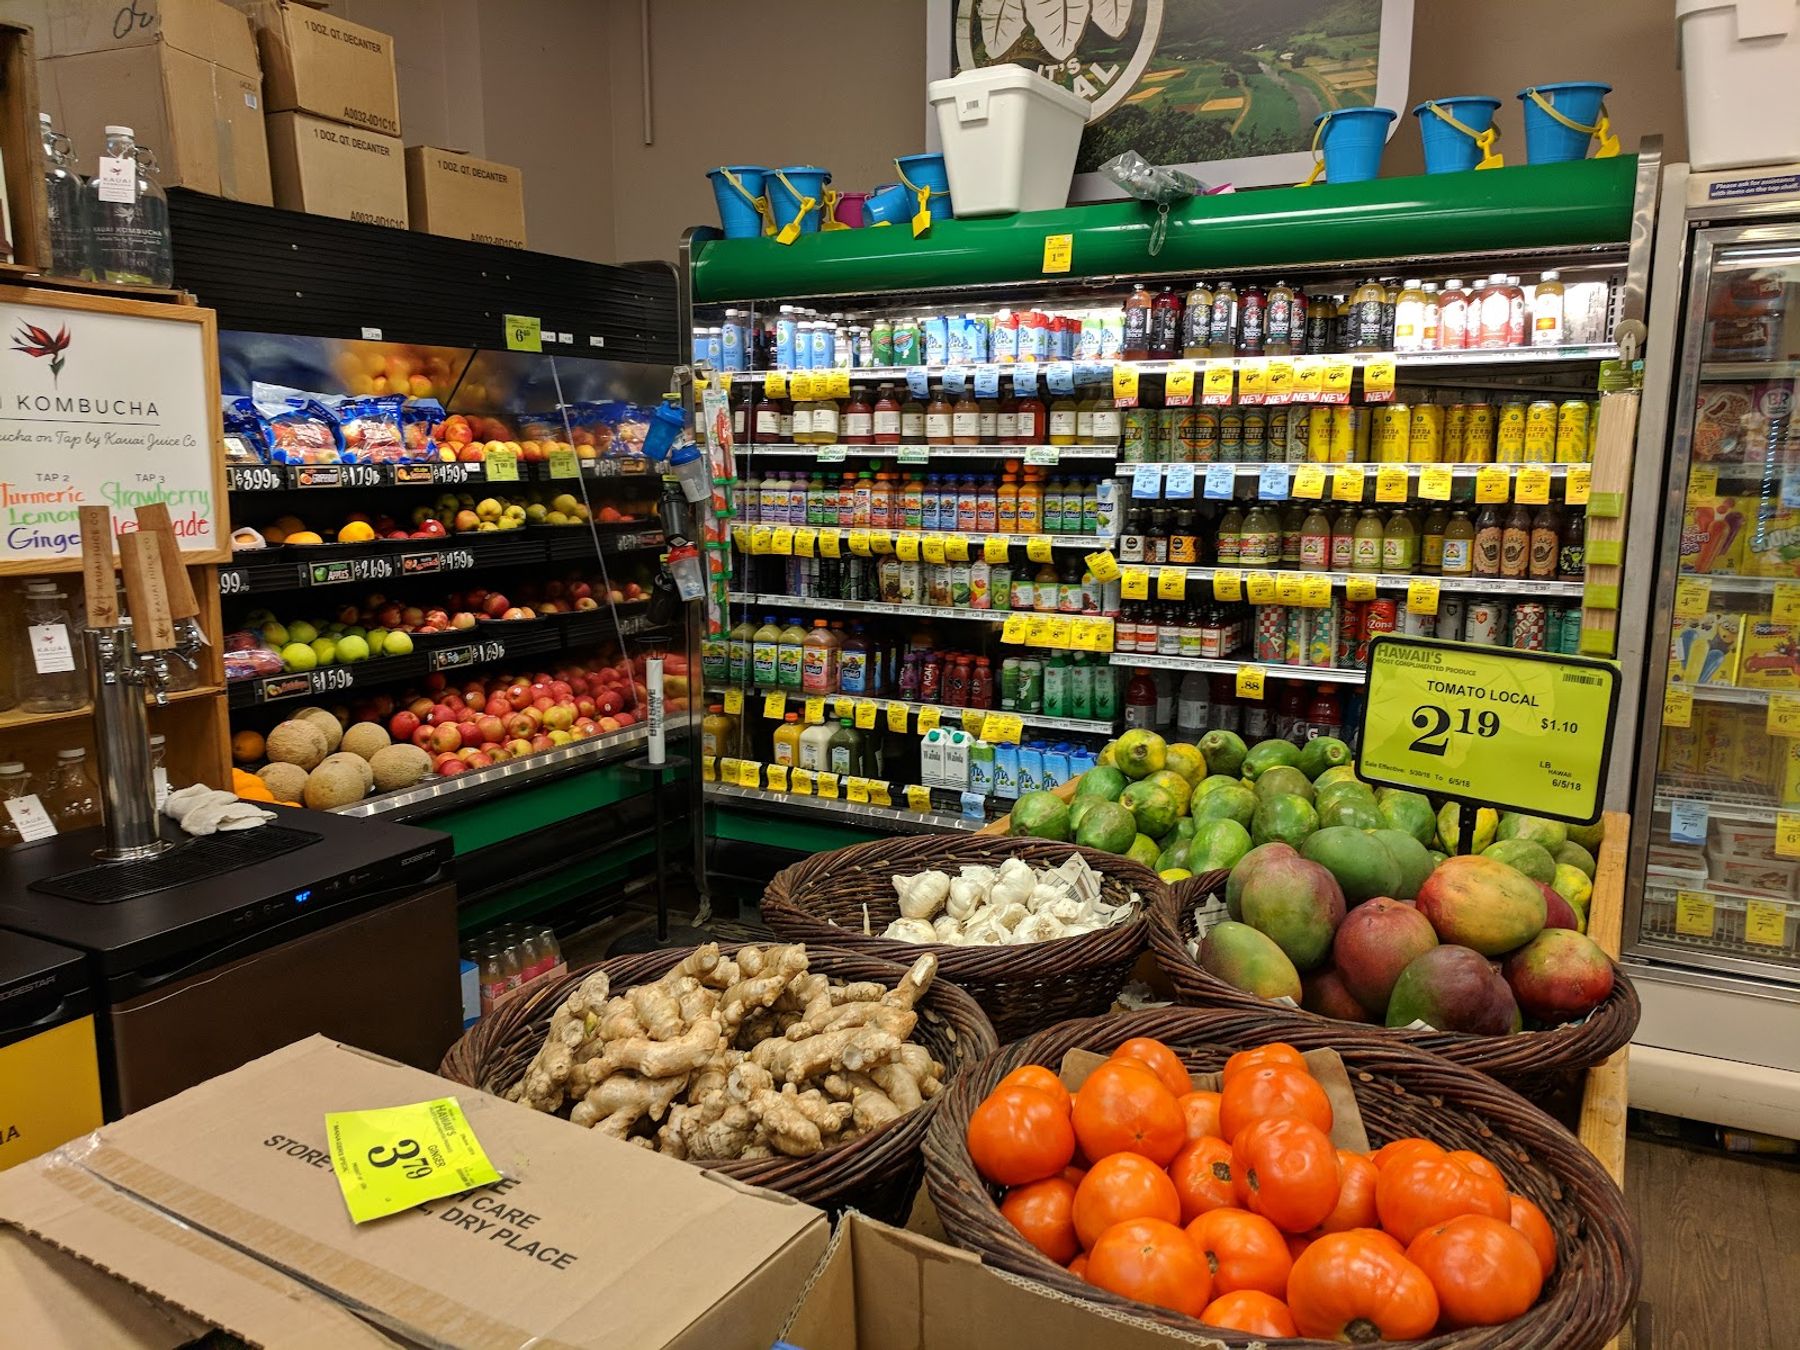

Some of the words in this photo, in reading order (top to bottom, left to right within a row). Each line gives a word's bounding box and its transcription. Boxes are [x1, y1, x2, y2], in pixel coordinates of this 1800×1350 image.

[311, 22, 328, 36] DOZ.
[343, 33, 383, 54] DECANTER
[320, 129, 338, 143] DOZ.
[351, 138, 390, 157] DECANTER
[472, 168, 508, 184] DECANTER
[1114, 397, 1136, 408] NEW
[1166, 395, 1192, 406] NEW
[1202, 394, 1230, 404] NEW
[1239, 394, 1264, 404] NEW
[1264, 394, 1291, 405] NEW
[1292, 392, 1320, 402] NEW
[1320, 393, 1348, 403] NEW
[1365, 392, 1392, 402] NEW
[17, 395, 160, 416] KOMBUCHA
[36, 435, 53, 443] on
[55, 430, 82, 449] Tap
[85, 432, 101, 449] by
[104, 432, 146, 446] Kauai
[147, 433, 181, 451] Juice
[182, 434, 197, 448] Co
[36, 472, 60, 482] TAP
[63, 474, 70, 482] 2
[136, 473, 156, 482] TAP
[159, 475, 166, 484] 3
[0, 482, 86, 508] Turmeric
[100, 481, 211, 517] Strawberry
[328, 570, 350, 581] APPLES
[1378, 644, 1442, 664] HAWAII'S
[1395, 659, 1444, 672] COMPLIMENTED
[1445, 666, 1477, 676] PRODUCE
[1427, 680, 1486, 700] TOMATO
[1490, 688, 1540, 707] LOCAL
[1541, 717, 1578, 734] $1.10
[1539, 760, 1552, 769] LB
[1548, 768, 1572, 778] HAWAII
[1448, 776, 1471, 788] 6/5/18
[1552, 778, 1582, 792] 6/5/18
[264, 1134, 330, 1170] STORE
[428, 1144, 446, 1168] GINGER
[471, 1196, 542, 1230] CARE
[439, 1206, 494, 1234] DRY
[489, 1226, 578, 1271] PLACE
